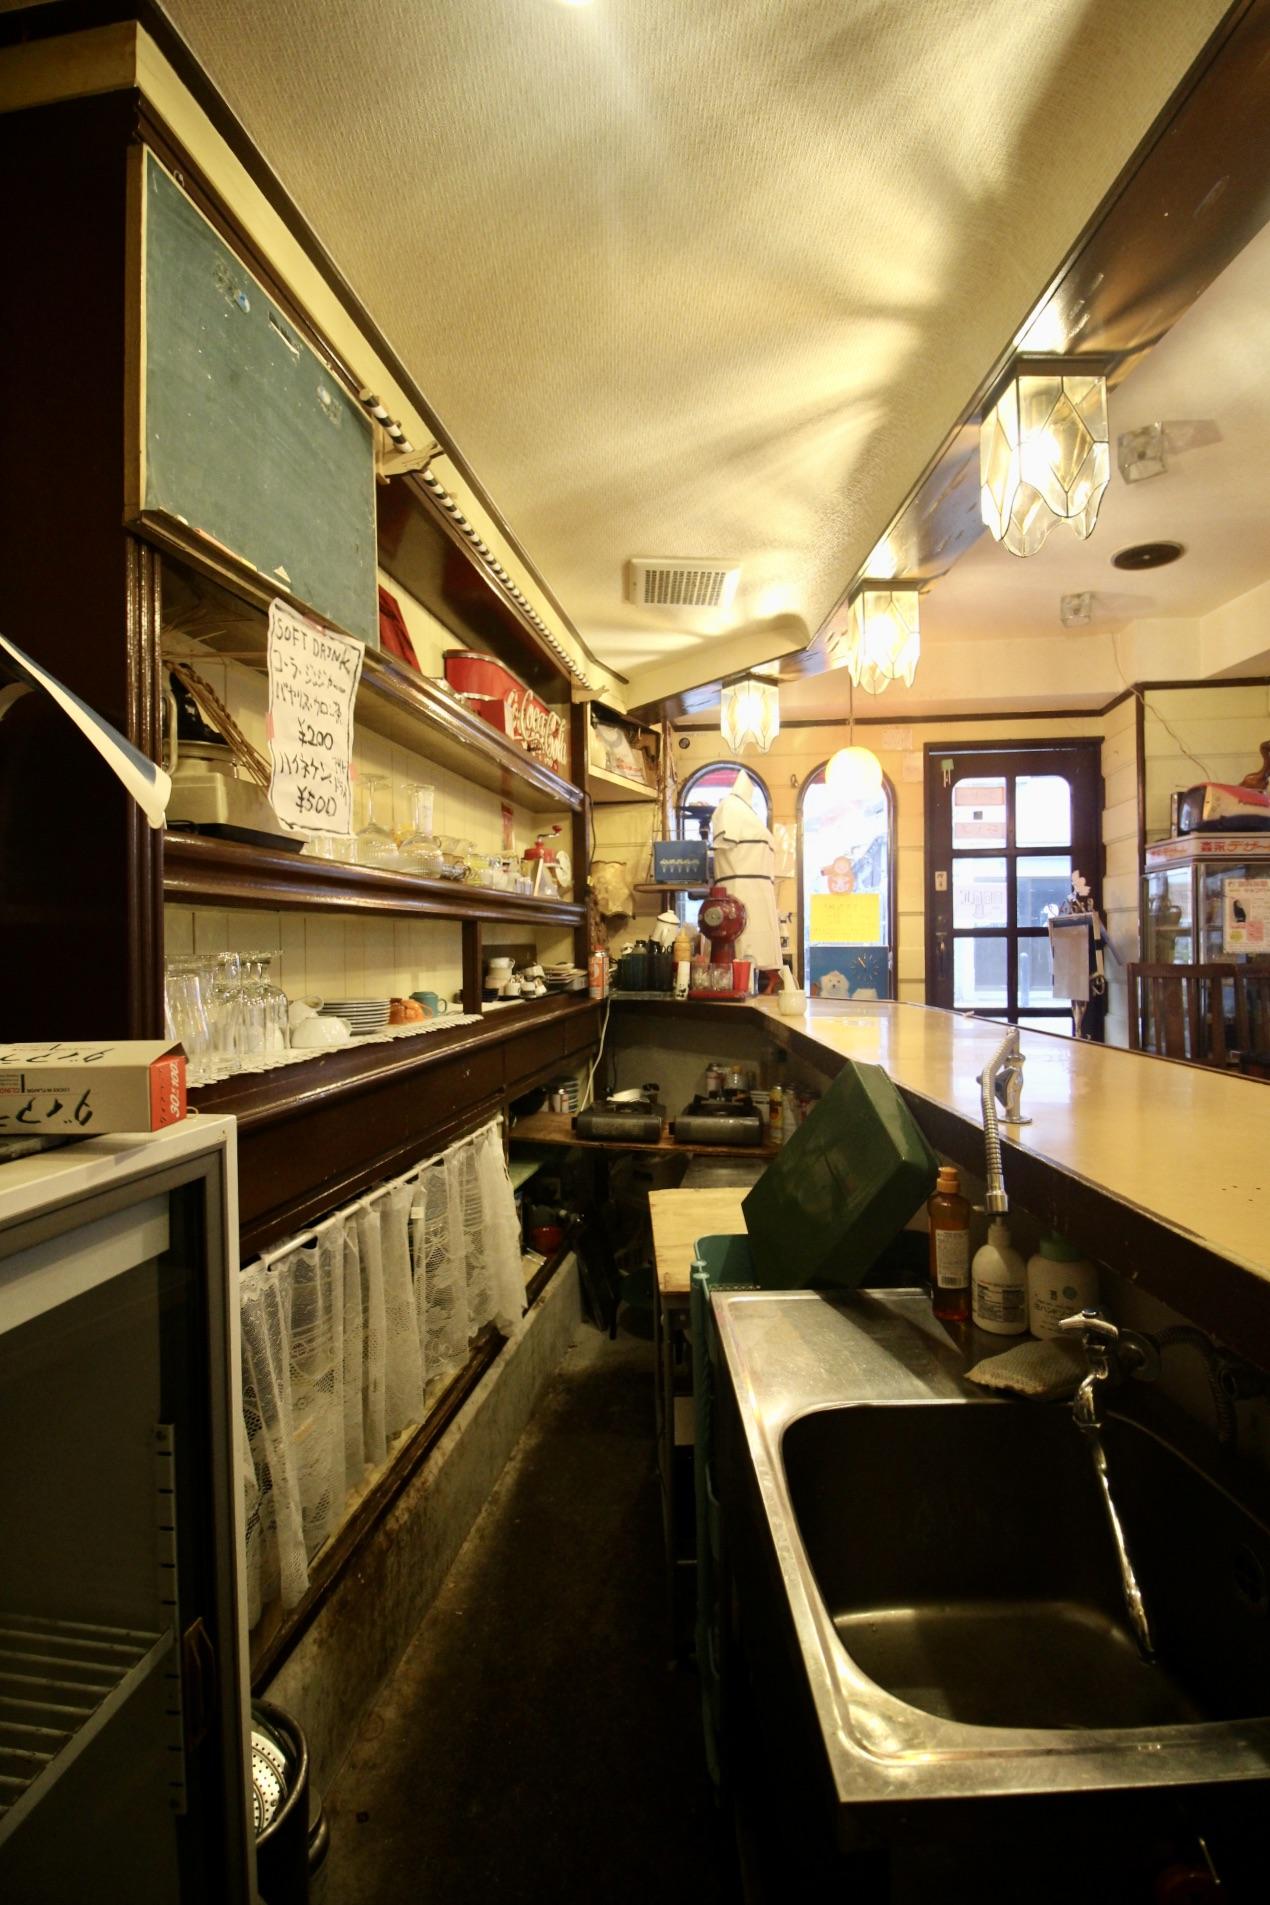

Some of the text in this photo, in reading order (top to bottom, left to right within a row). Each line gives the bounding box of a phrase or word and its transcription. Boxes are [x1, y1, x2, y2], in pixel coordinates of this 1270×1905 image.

[275, 617, 351, 675] SOFT DRINK
[298, 717, 334, 751] ¥200
[296, 786, 338, 817] ¥500
